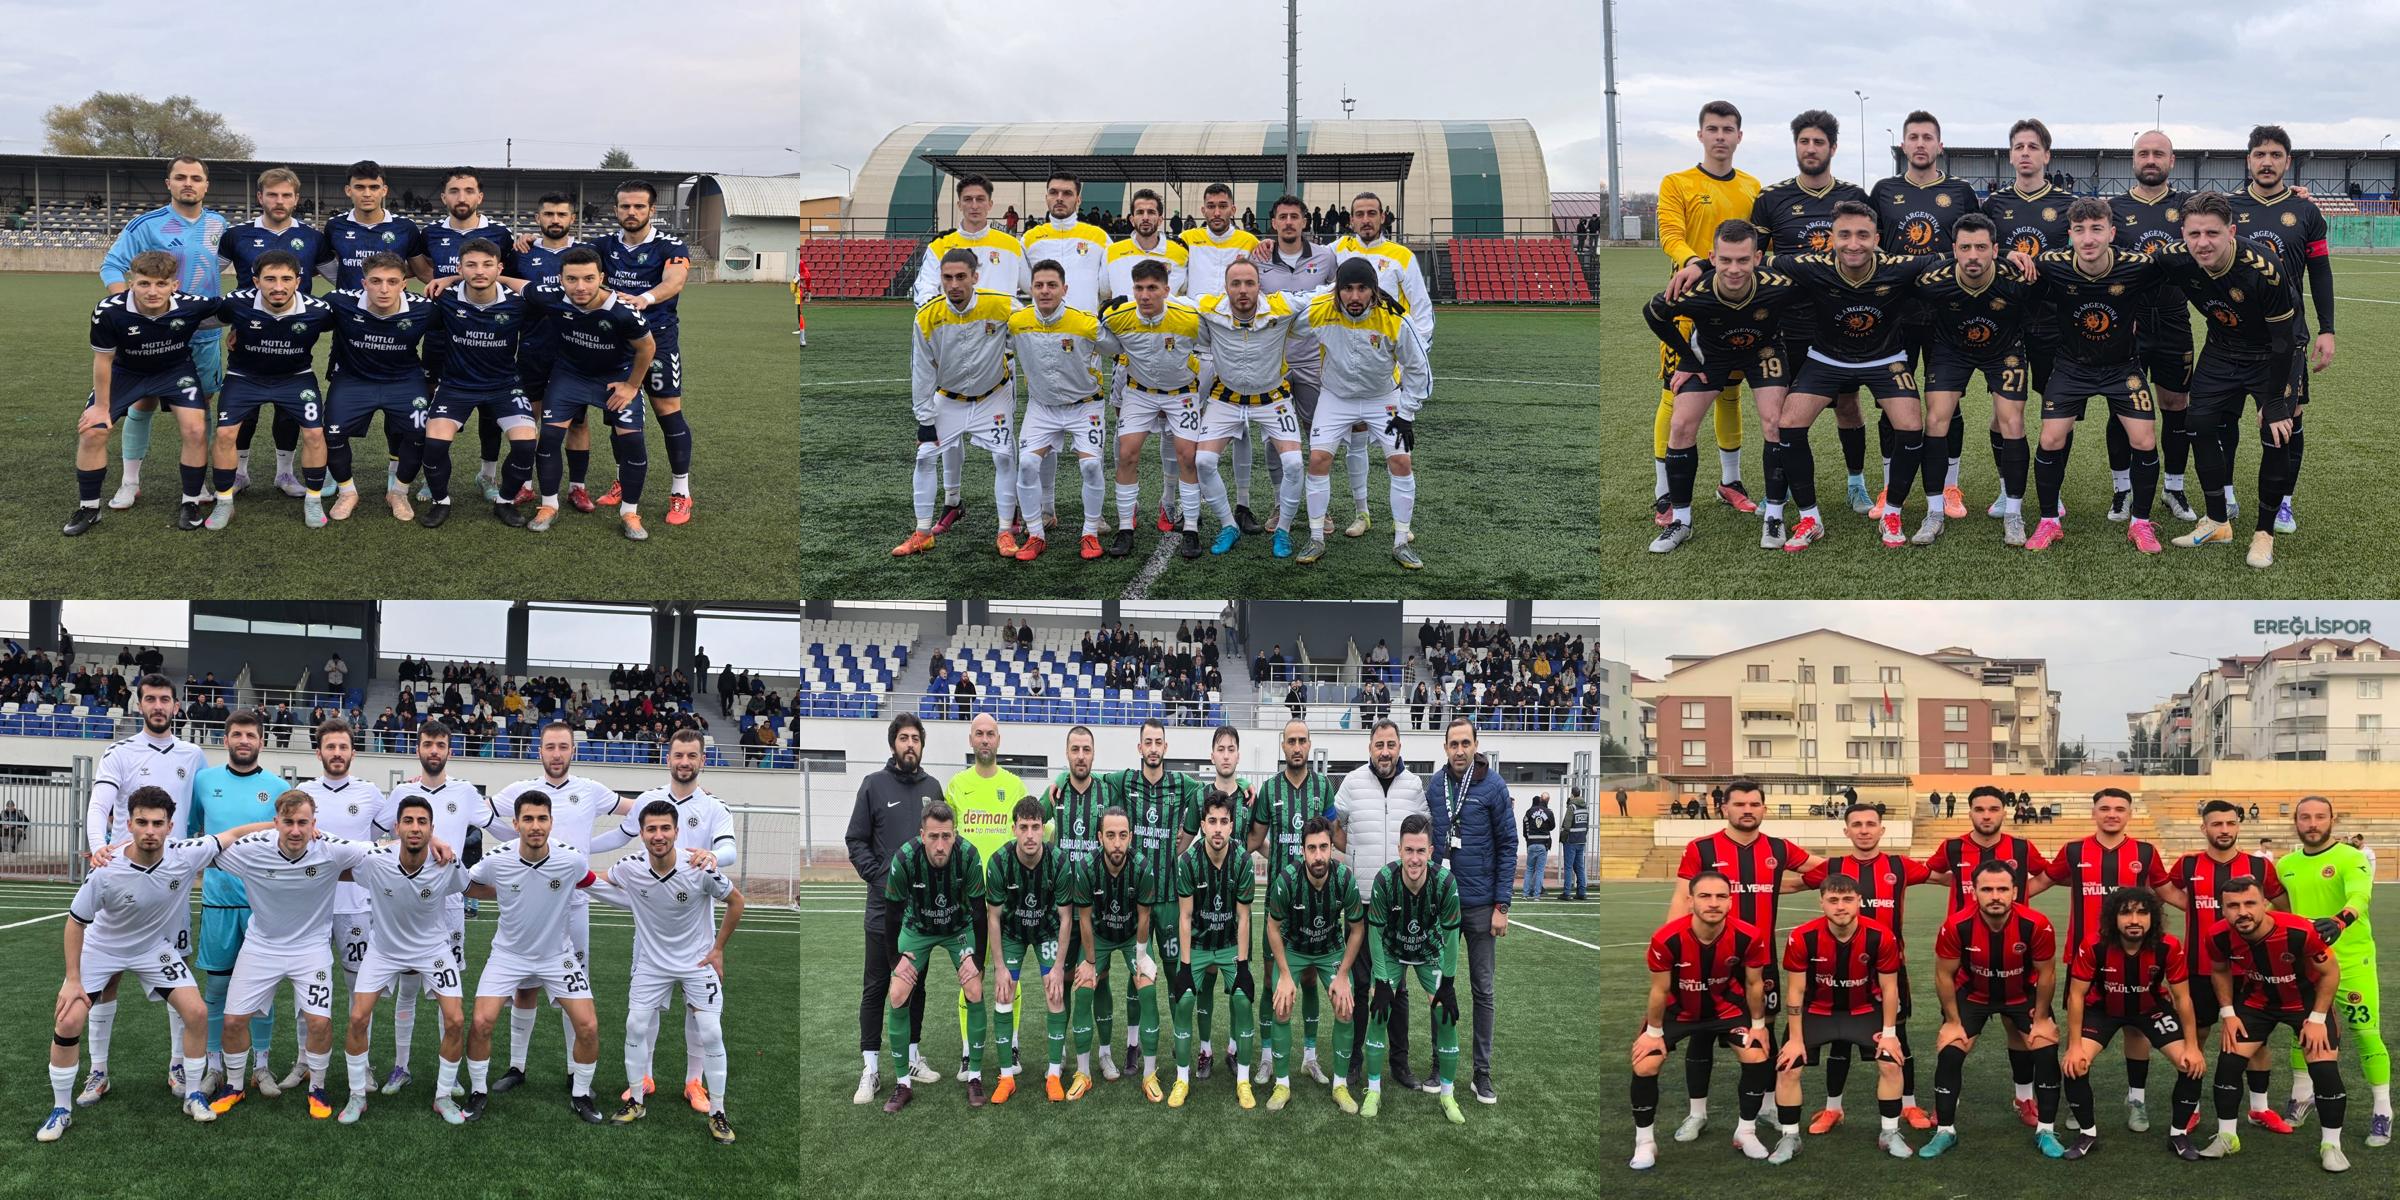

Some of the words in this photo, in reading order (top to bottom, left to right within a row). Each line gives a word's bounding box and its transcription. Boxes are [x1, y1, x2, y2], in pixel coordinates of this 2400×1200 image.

[1805, 220, 1832, 231] ARGEN
[1905, 211, 1941, 234] ARGENTINA
[2011, 226, 2048, 248] ARGENTINA
[2078, 302, 2118, 321] ARGENTINA
[364, 334, 395, 344] MUTLU
[452, 335, 508, 347] GAYRİMENKUL
[466, 330, 495, 340] MUTLU
[572, 330, 600, 342] MUTLU
[141, 339, 172, 350] MUTLU
[245, 344, 304, 356] GAYRİMENKUL
[260, 339, 291, 348] MUTLU
[1759, 357, 1782, 379] 19
[651, 372, 664, 391] 5
[1892, 371, 1918, 391] 10
[2001, 369, 2025, 392] 27
[181, 386, 198, 401] 7
[2129, 389, 2152, 412] 18
[304, 402, 318, 421] 8
[511, 396, 533, 412] 15
[409, 410, 428, 428] 16
[617, 409, 633, 423] 2
[1179, 411, 1199, 431] 28
[1277, 415, 1297, 433] 10
[990, 428, 1010, 445] 37
[1088, 429, 1104, 448] 61
[963, 808, 1008, 825] derman
[1134, 824, 1153, 837] AĞARLAR
[1060, 836, 1081, 849] AĞARLAR
[1143, 838, 1160, 849] EMLAK
[1289, 845, 1303, 855] EMLA
[1747, 884, 1774, 893] YEMEK
[2083, 885, 2108, 896] EYLÜL
[1867, 899, 1895, 908] YEMEK
[2195, 898, 2221, 909] EYLÜL
[933, 916, 952, 925] EMLAK
[1022, 918, 1040, 927] EMLAK
[346, 941, 368, 962] 20
[1041, 941, 1058, 960] 58
[1163, 937, 1178, 958] 15
[433, 968, 458, 988] 30
[1431, 969, 1443, 991] 7
[1995, 966, 2024, 978] YEMEK
[2264, 973, 2297, 984] YEMEK
[563, 971, 588, 992] 25
[1679, 980, 1708, 992] EYLÜL
[1840, 976, 1869, 987] YEMEK
[307, 984, 330, 1009] 52
[706, 982, 718, 1005] 7
[2346, 1005, 2371, 1024] 23
[2154, 1015, 2179, 1035] 15
